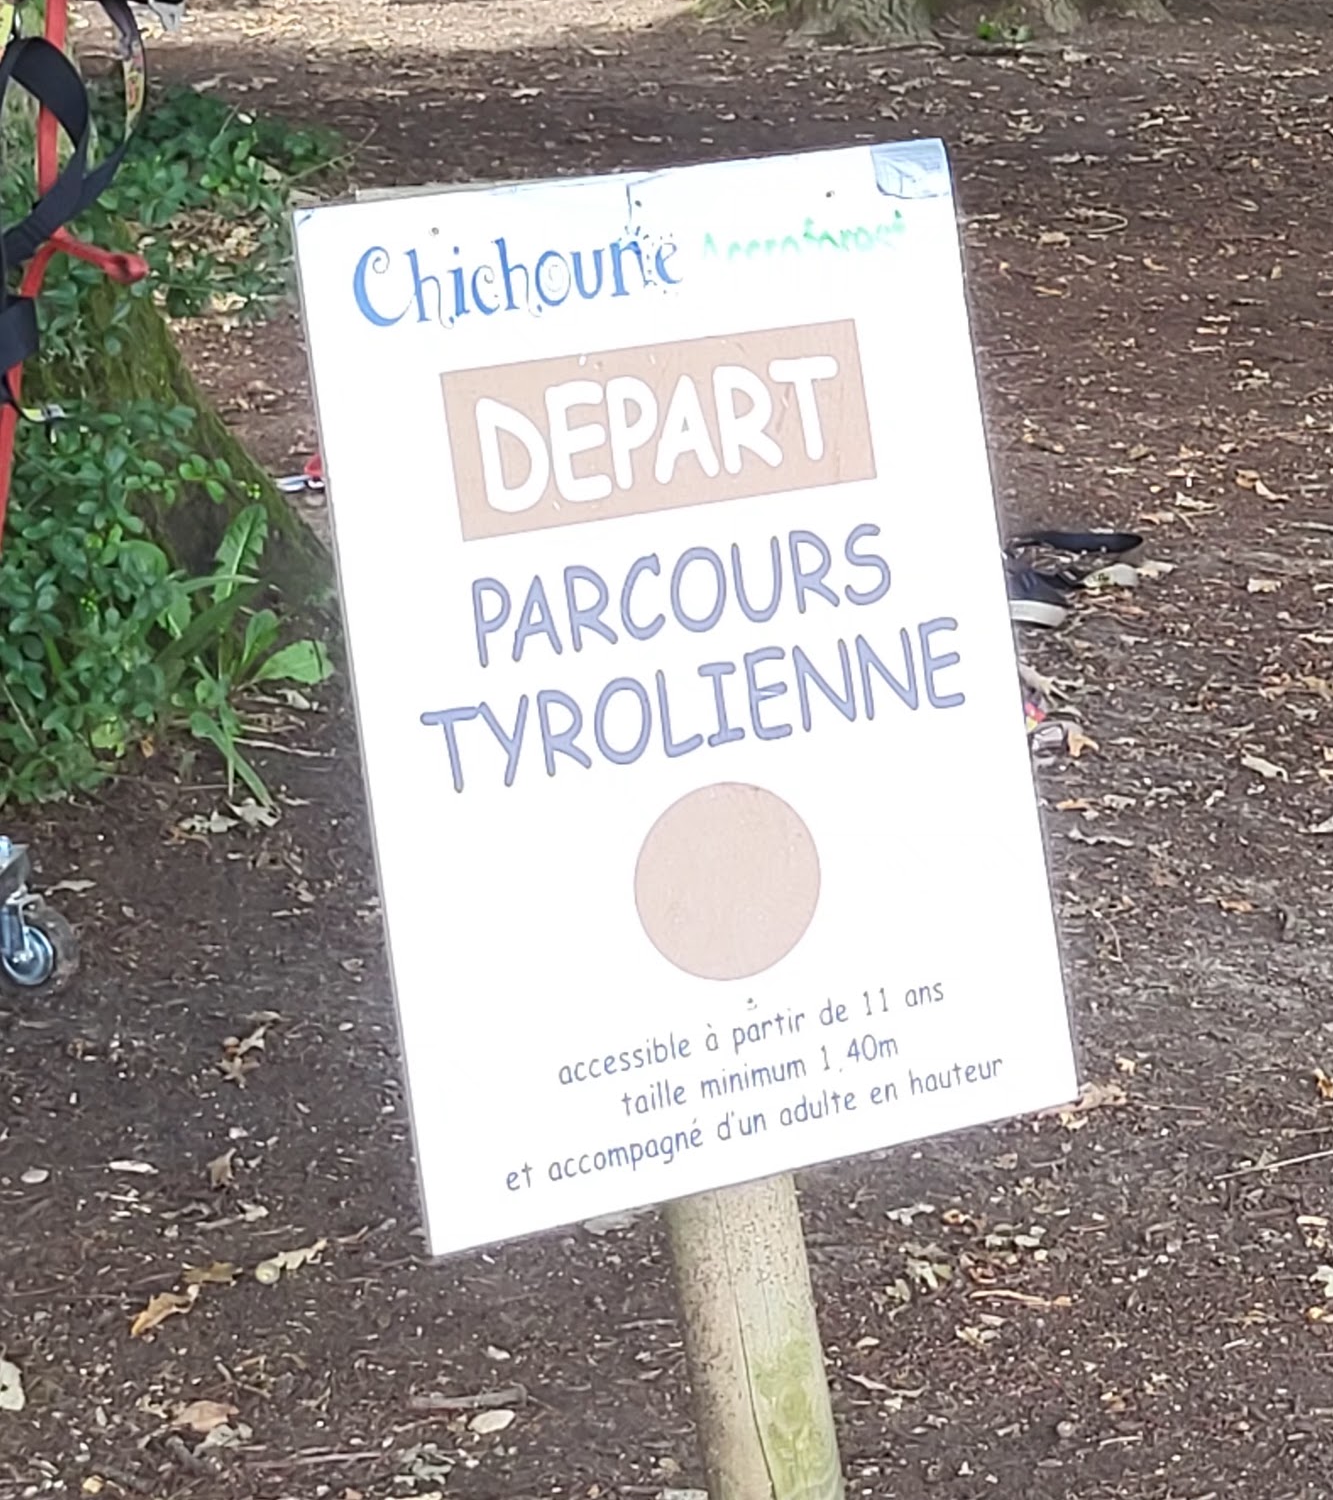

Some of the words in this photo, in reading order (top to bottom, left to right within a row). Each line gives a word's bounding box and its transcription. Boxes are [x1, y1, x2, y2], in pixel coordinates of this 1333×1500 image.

[352, 237, 683, 329] Chichoune
[475, 356, 839, 513] DEPART
[472, 523, 891, 668] PARCOURS
[420, 617, 965, 794] TYROLIENNE
[559, 1031, 693, 1085] accessible
[706, 1023, 719, 1052] à
[733, 1008, 805, 1055] partir
[819, 998, 848, 1026] de
[863, 988, 889, 1016] 11
[905, 983, 944, 1007] ans
[621, 1088, 688, 1117] taille
[701, 1059, 806, 1098] minimum
[506, 1162, 533, 1191] et
[548, 1118, 704, 1181] accompagné
[717, 1111, 768, 1141] d'un
[780, 1089, 858, 1126] adulte
[870, 1083, 899, 1105] en
[909, 1059, 1003, 1095] hauteur
